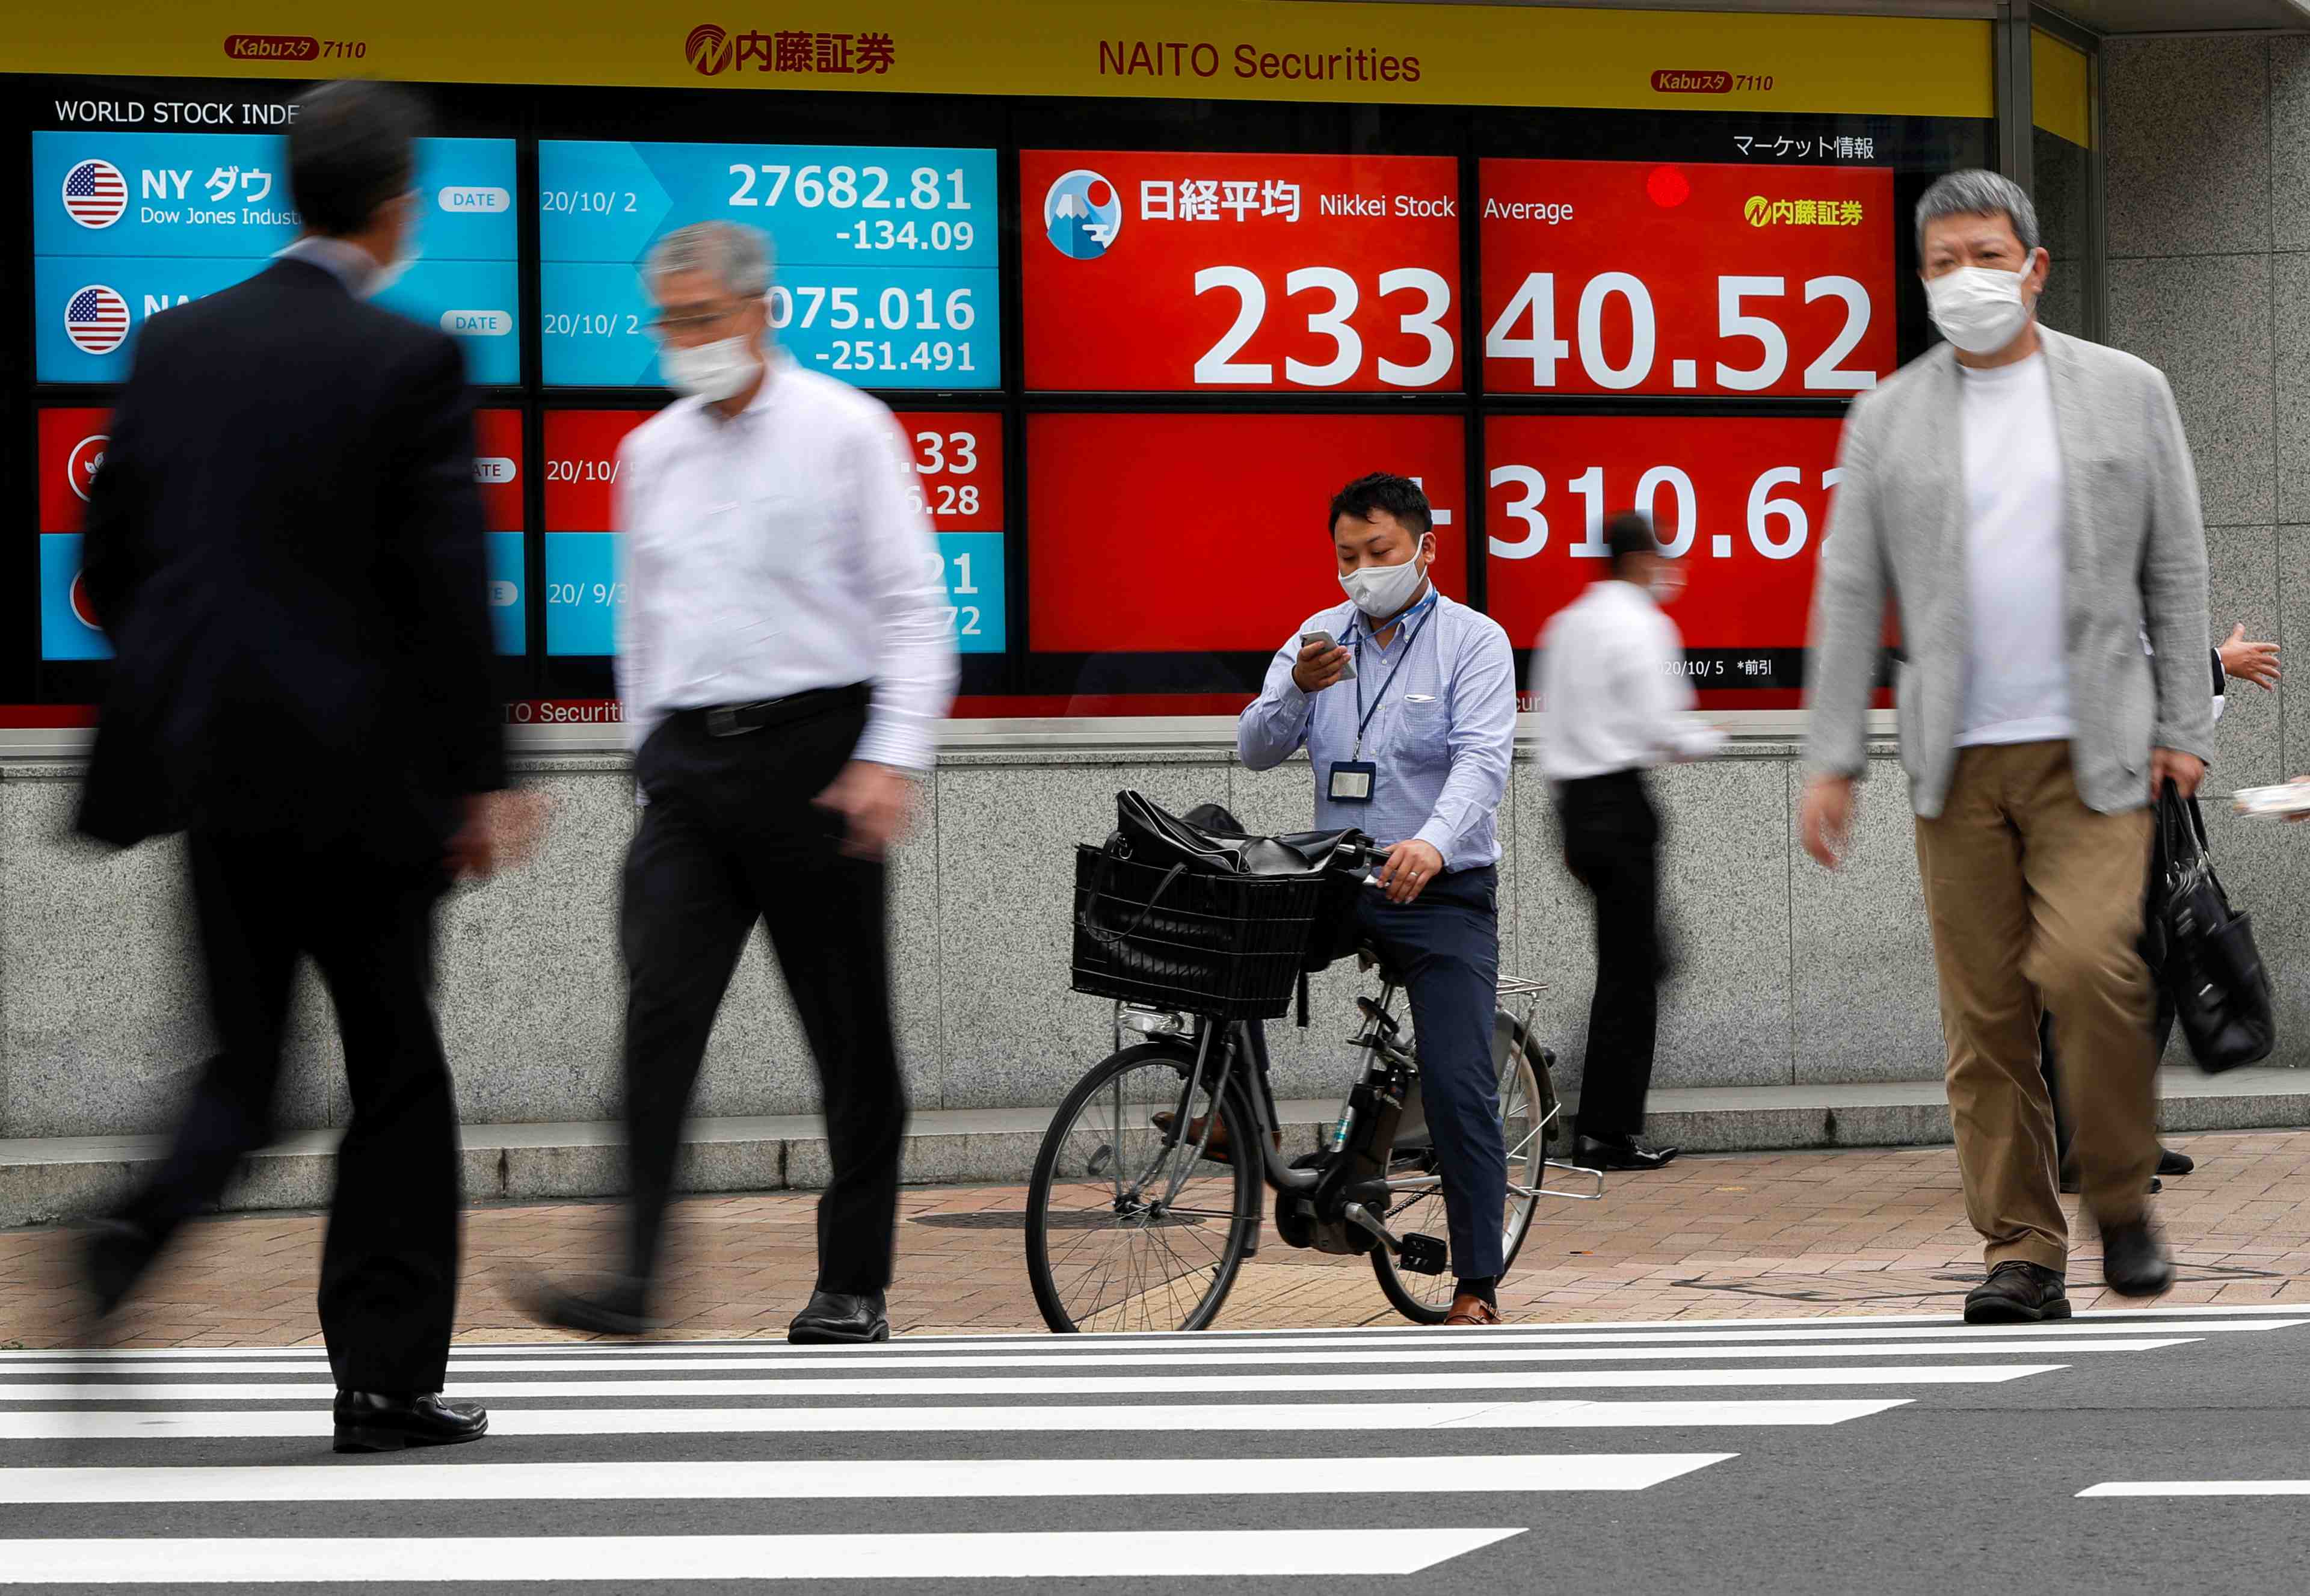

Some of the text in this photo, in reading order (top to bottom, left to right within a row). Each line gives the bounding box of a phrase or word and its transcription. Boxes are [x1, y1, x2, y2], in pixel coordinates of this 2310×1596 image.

[323, 41, 366, 58] 7110
[735, 29, 896, 75] 内藤証券
[1100, 40, 1421, 82] NAITO Securities
[1736, 75, 1774, 91] 7110
[55, 100, 303, 125] WORLD STOCK INDE
[1733, 135, 1874, 159] マーケット情報
[141, 165, 273, 203] NY ダウ
[728, 163, 972, 210] 27682.81
[453, 193, 496, 207] DATE
[1140, 178, 1574, 225] 日経平均 Nikkei Stock Average
[1772, 199, 1864, 226] 内藤証券
[140, 206, 180, 224] Dow
[185, 206, 236, 225] Jones
[836, 220, 975, 251] -134.09
[455, 316, 497, 331] DATE
[815, 340, 976, 372] -251.491
